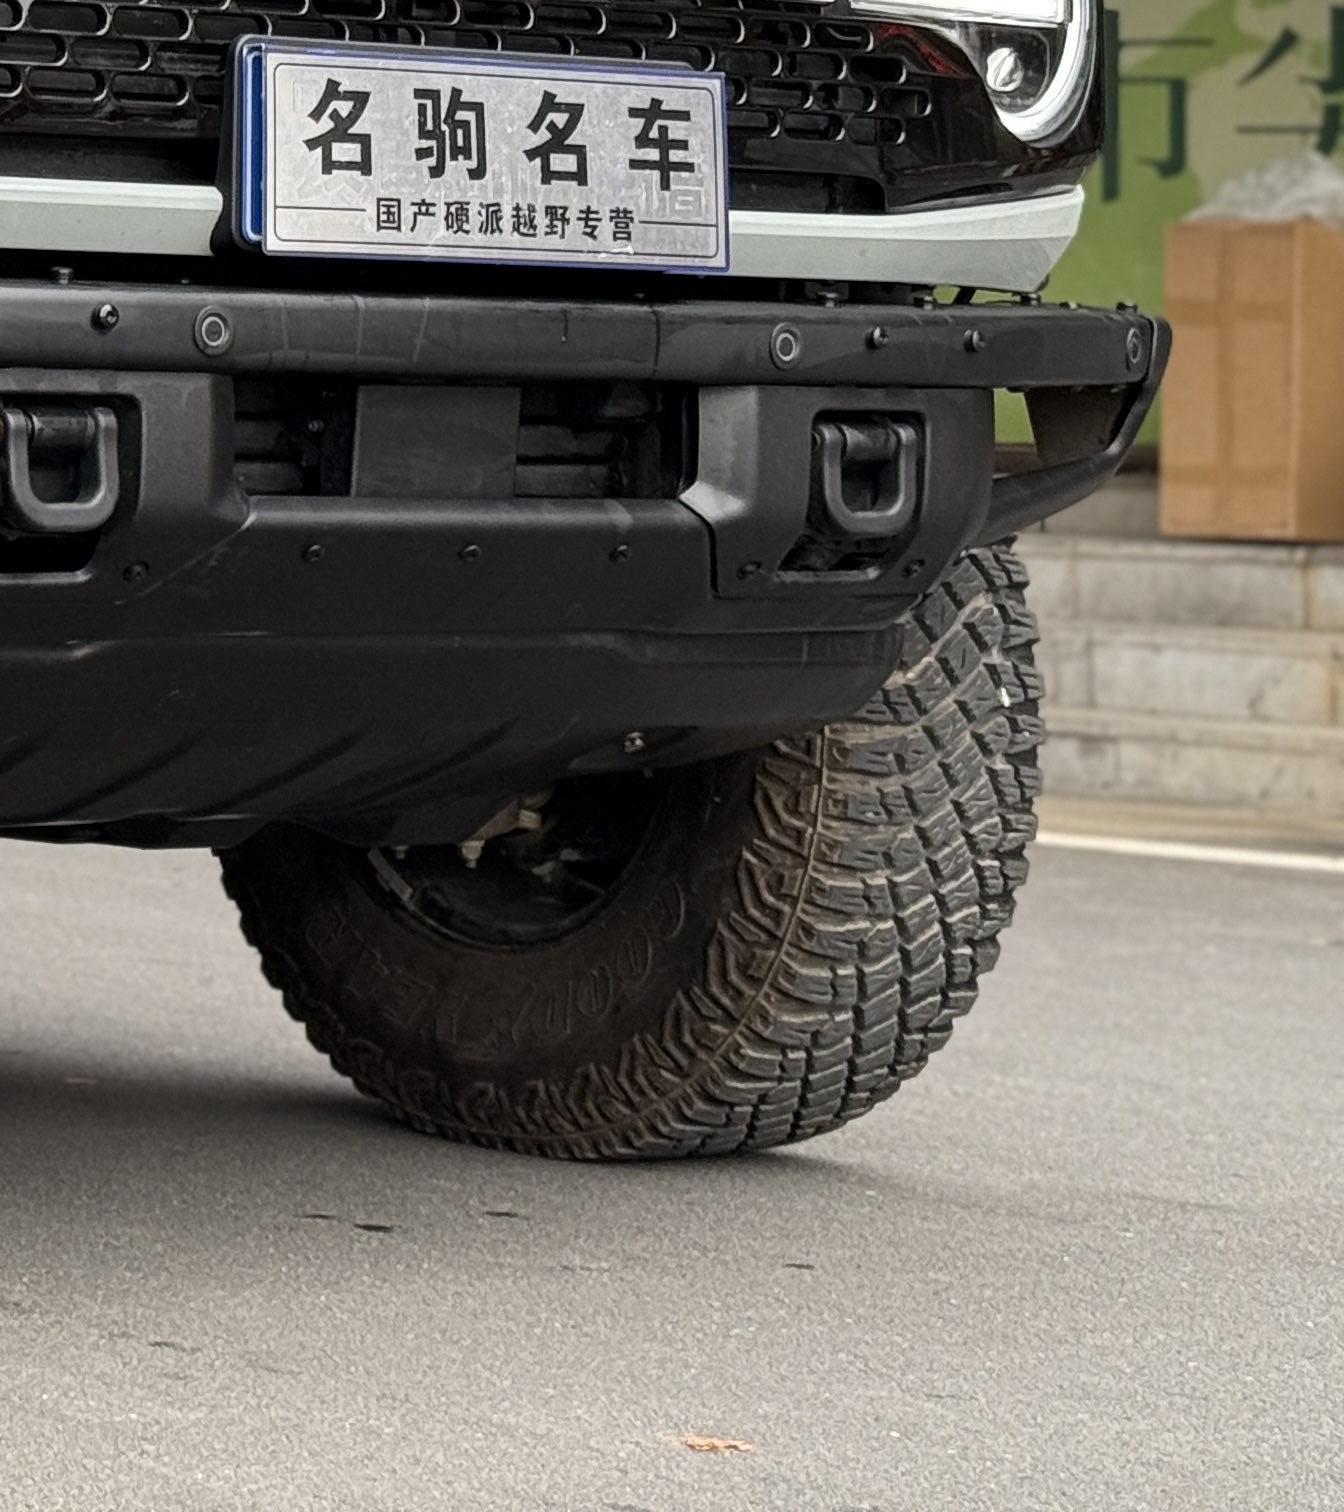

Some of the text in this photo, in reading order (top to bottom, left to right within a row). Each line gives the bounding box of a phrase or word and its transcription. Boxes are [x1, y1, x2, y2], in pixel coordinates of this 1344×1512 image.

[302, 77, 696, 192] 名驹名车
[375, 196, 636, 243] 国产硬派越野专营
